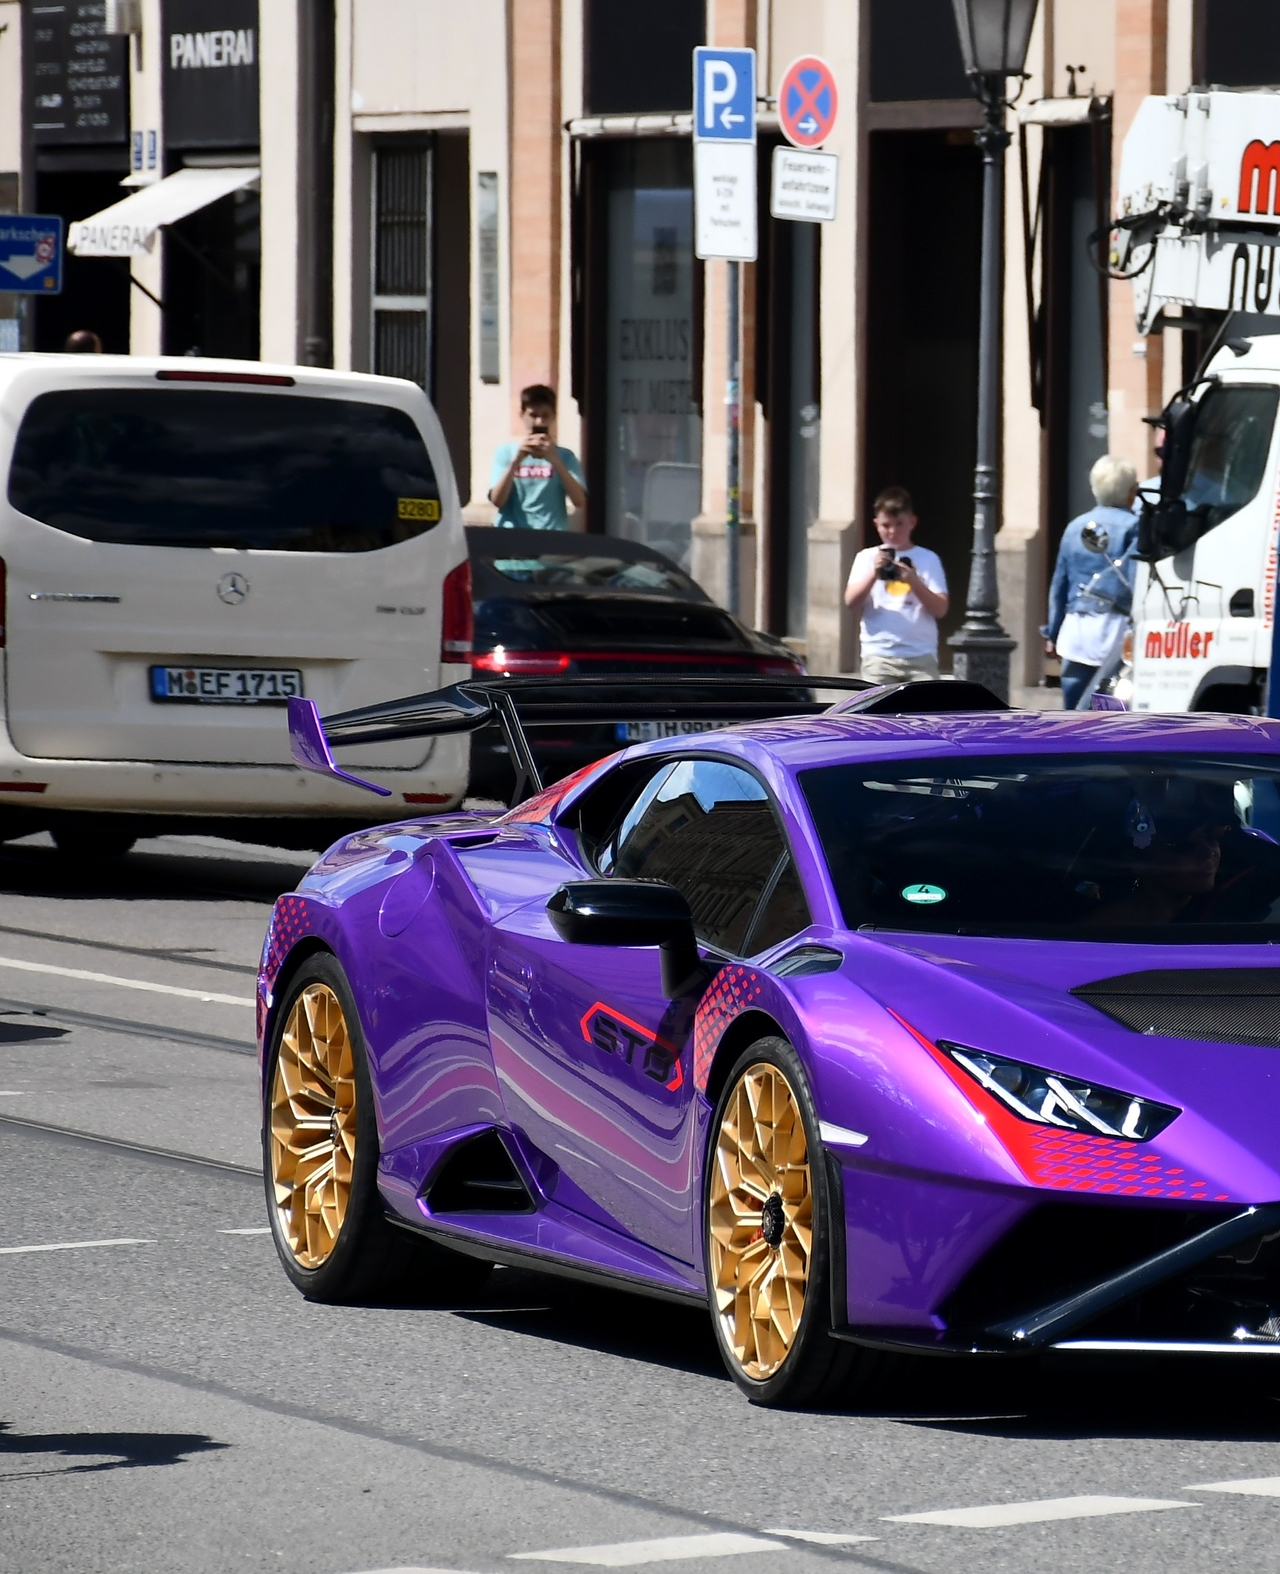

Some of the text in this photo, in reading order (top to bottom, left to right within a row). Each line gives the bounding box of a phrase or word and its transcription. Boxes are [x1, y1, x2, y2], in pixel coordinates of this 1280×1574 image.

[170, 29, 254, 69] PANERAI
[704, 60, 738, 128] P
[1145, 621, 1214, 658] müller
[168, 671, 297, 697] M EF 1715
[918, 885, 930, 893] 4
[594, 1014, 675, 1083] STO
